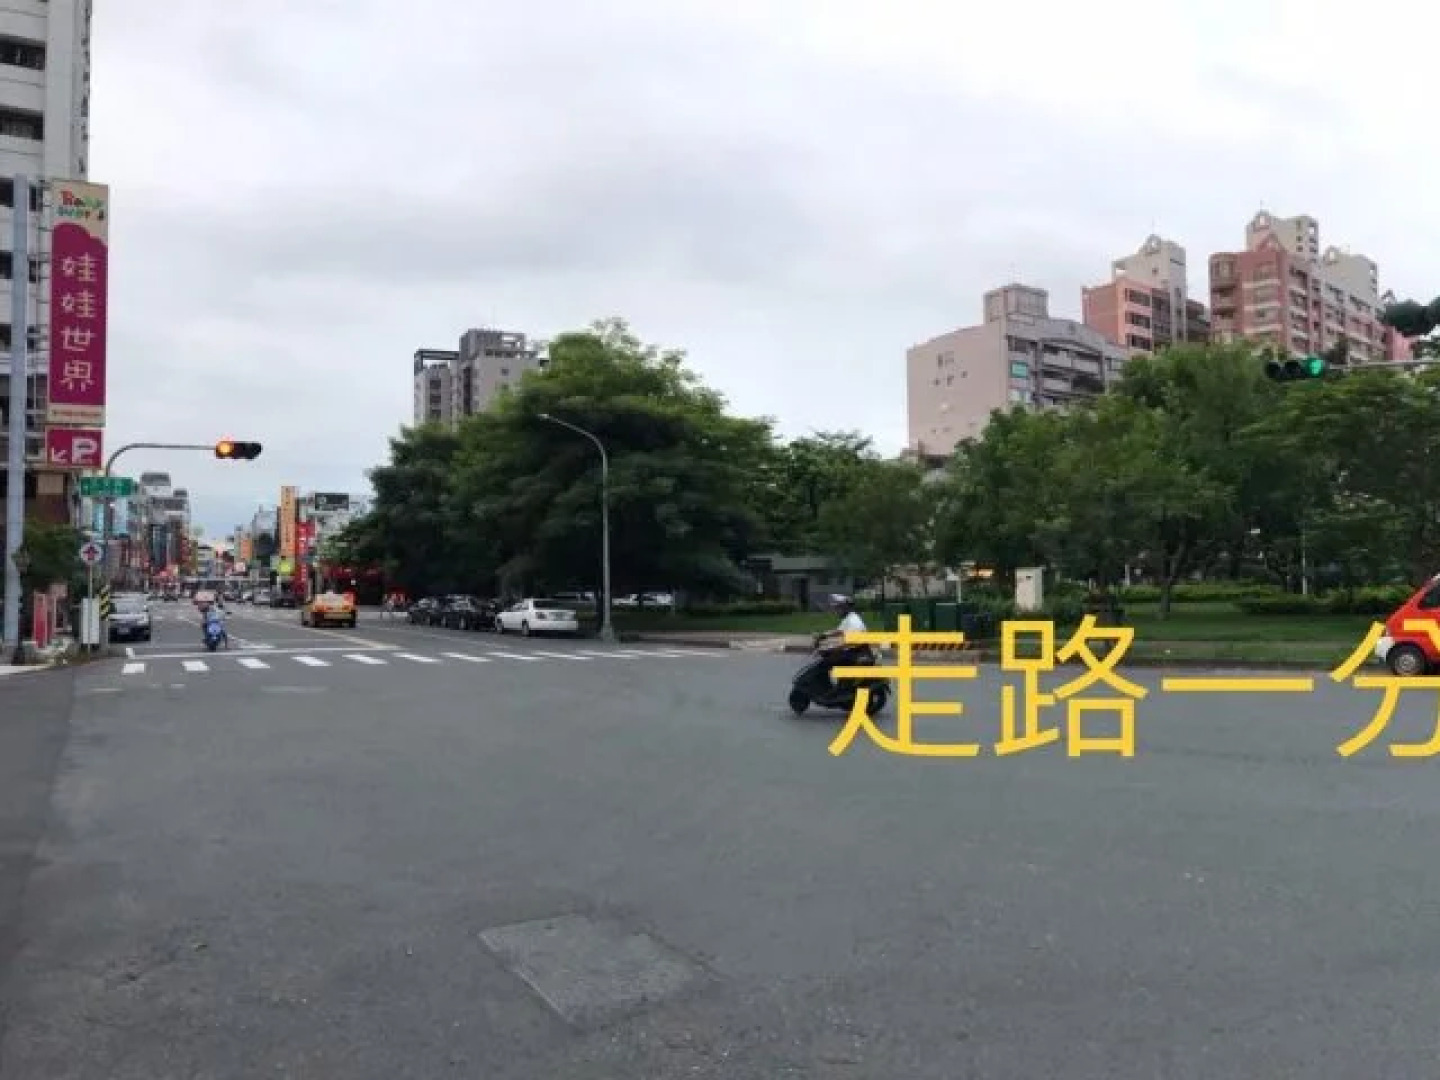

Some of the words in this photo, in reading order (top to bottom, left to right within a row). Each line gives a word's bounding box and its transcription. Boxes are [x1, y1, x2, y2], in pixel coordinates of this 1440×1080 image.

[61, 252, 97, 392] 娃娃世界
[72, 438, 98, 464] P
